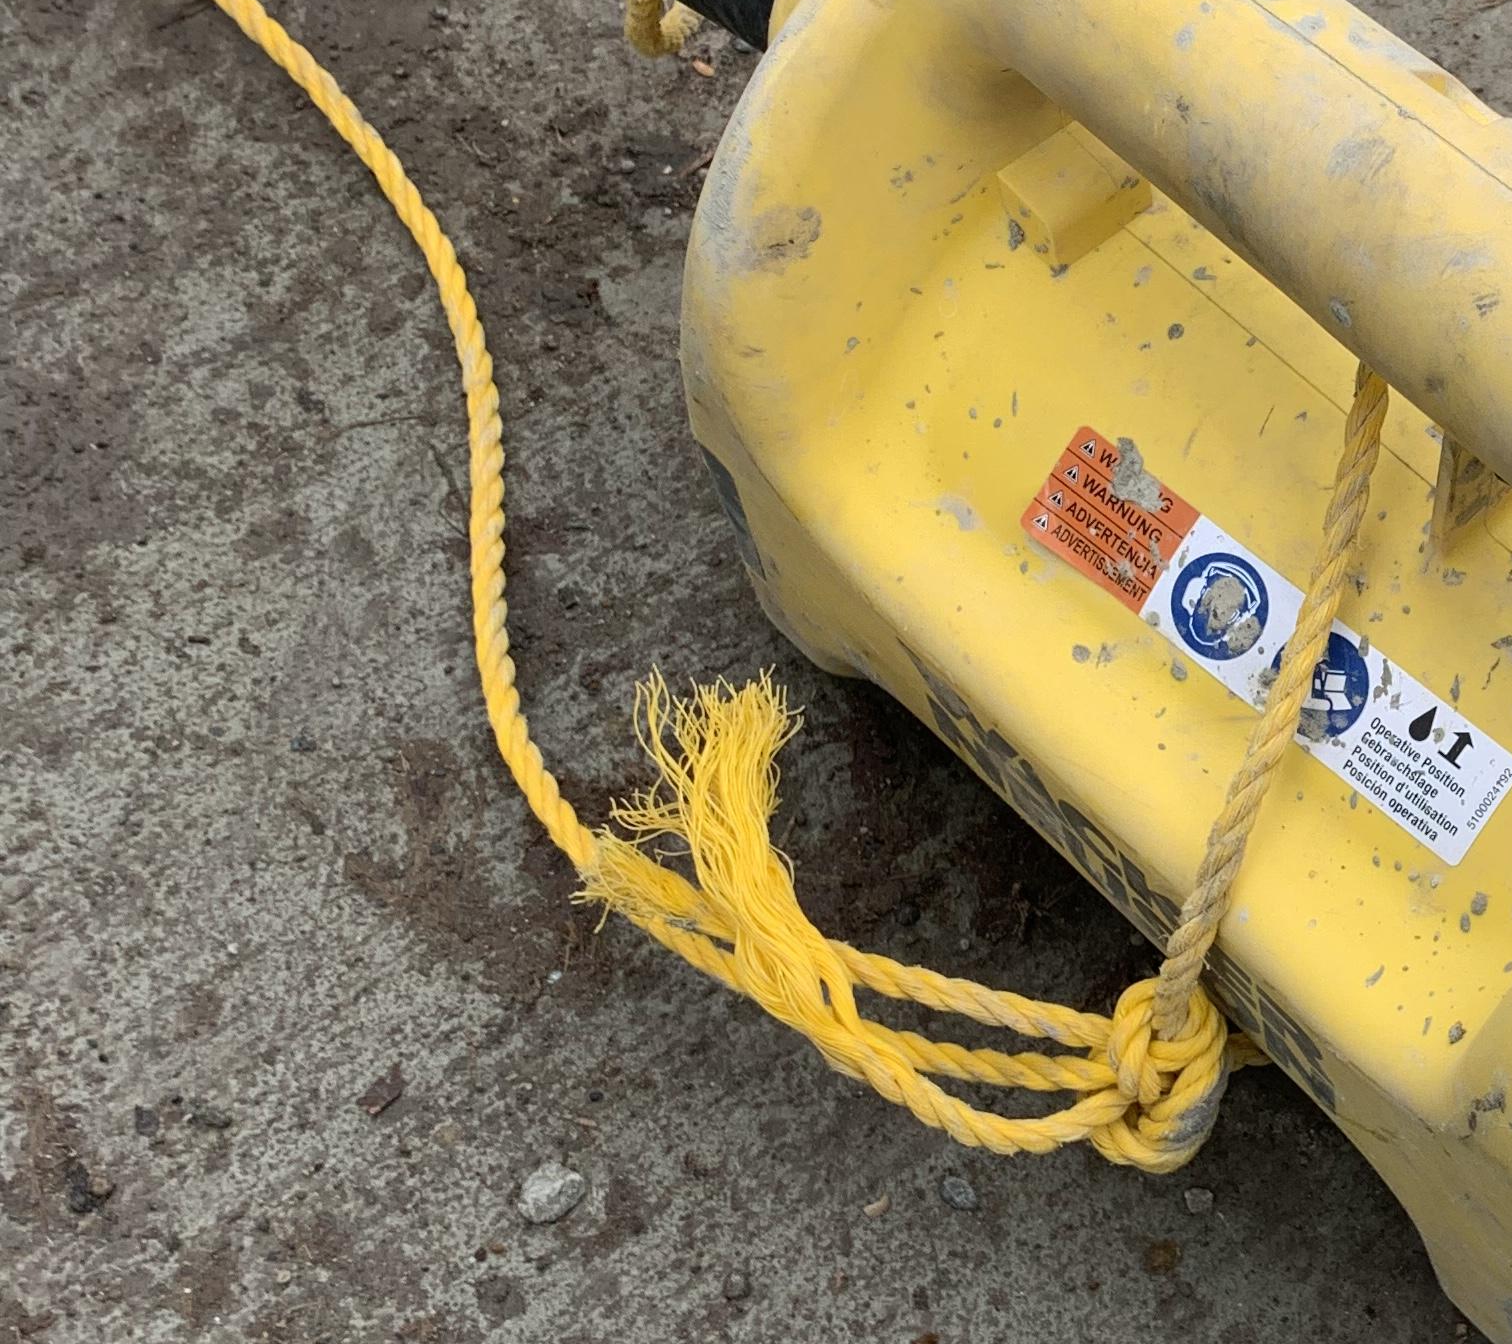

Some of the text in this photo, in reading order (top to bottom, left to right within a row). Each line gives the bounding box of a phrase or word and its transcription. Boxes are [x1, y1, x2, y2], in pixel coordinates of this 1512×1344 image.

[1066, 502, 1157, 580] ADVERTENCIA
[1083, 473, 1163, 544] WARNUNG
[1342, 759, 1438, 842] Posición operativa
[1351, 745, 1458, 837] Position d'utilisation
[1421, 756, 1466, 798] Position
[895, 635, 1335, 1088] WACKER
